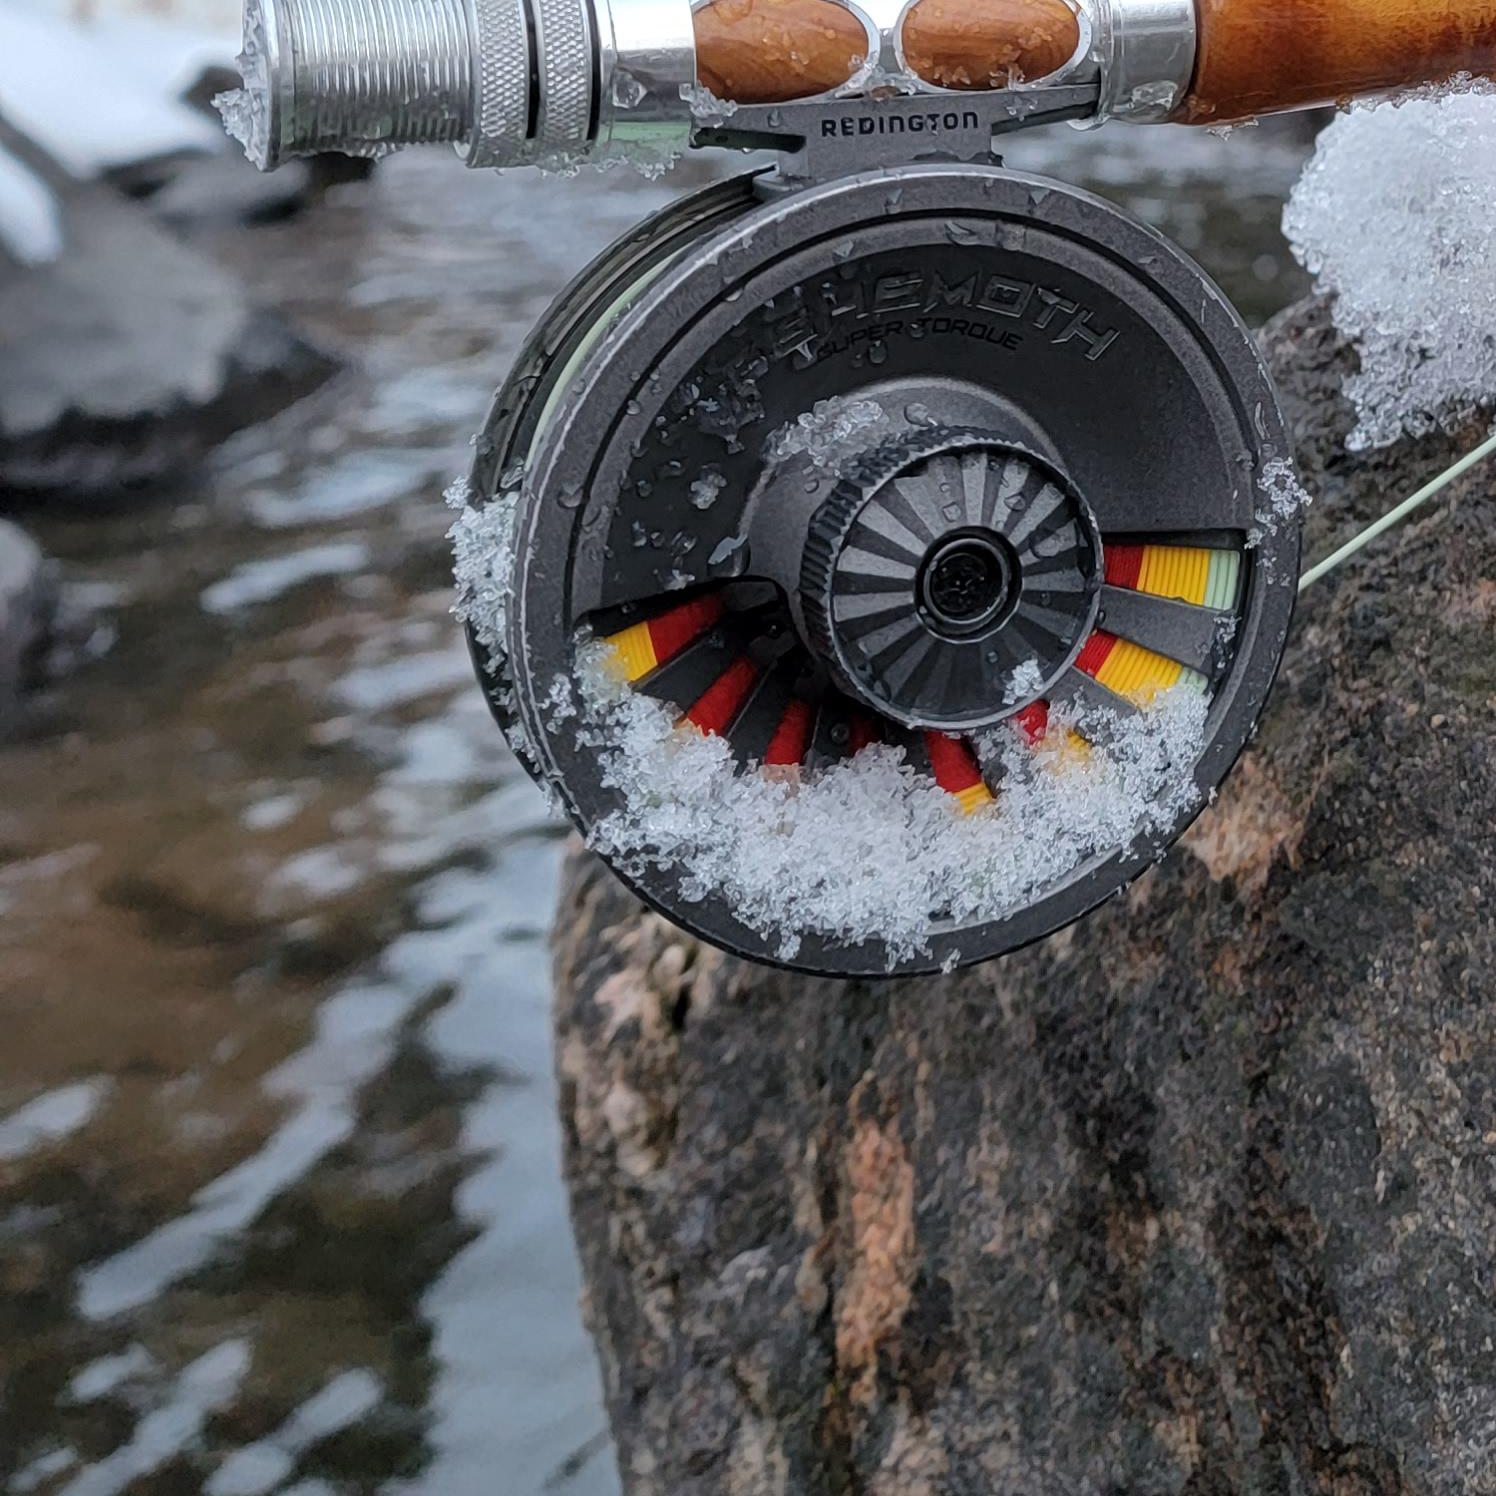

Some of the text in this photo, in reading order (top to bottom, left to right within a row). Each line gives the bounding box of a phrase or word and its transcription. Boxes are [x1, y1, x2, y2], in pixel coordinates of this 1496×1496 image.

[820, 111, 979, 138] REDINGTON
[817, 317, 1023, 363] SUPER TORQUE
